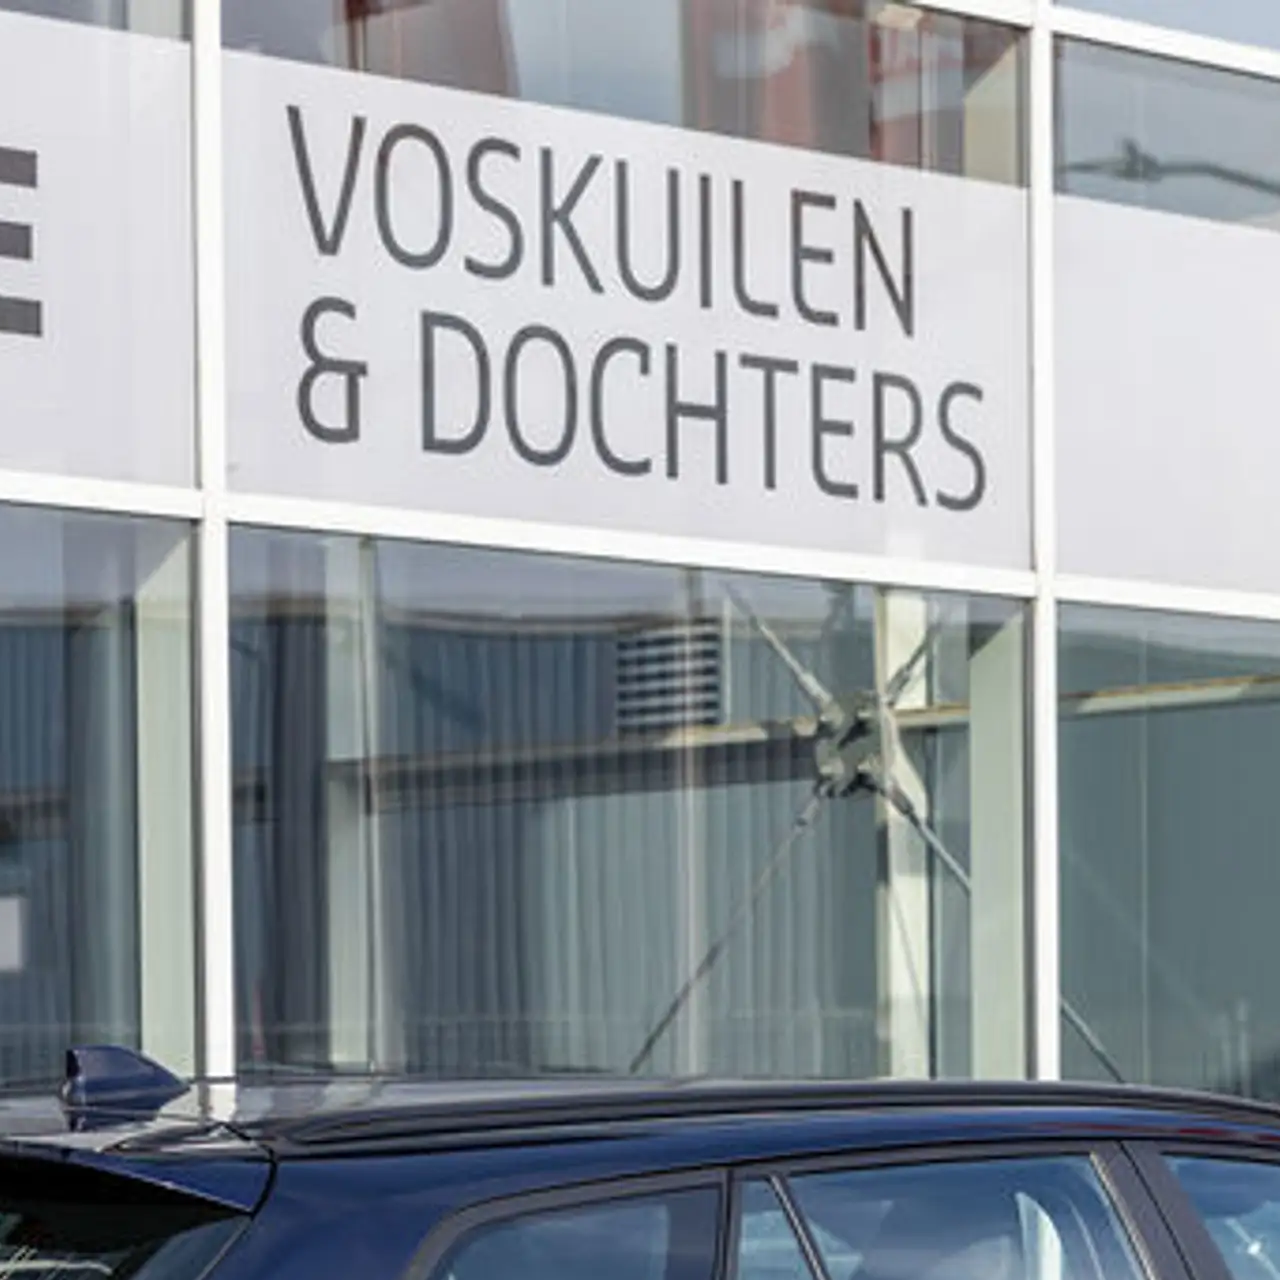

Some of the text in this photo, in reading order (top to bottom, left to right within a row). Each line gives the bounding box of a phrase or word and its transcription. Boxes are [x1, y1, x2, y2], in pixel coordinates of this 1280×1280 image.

[286, 104, 916, 339] VOSKUILEN
[296, 296, 988, 513] & DOCHTERS
